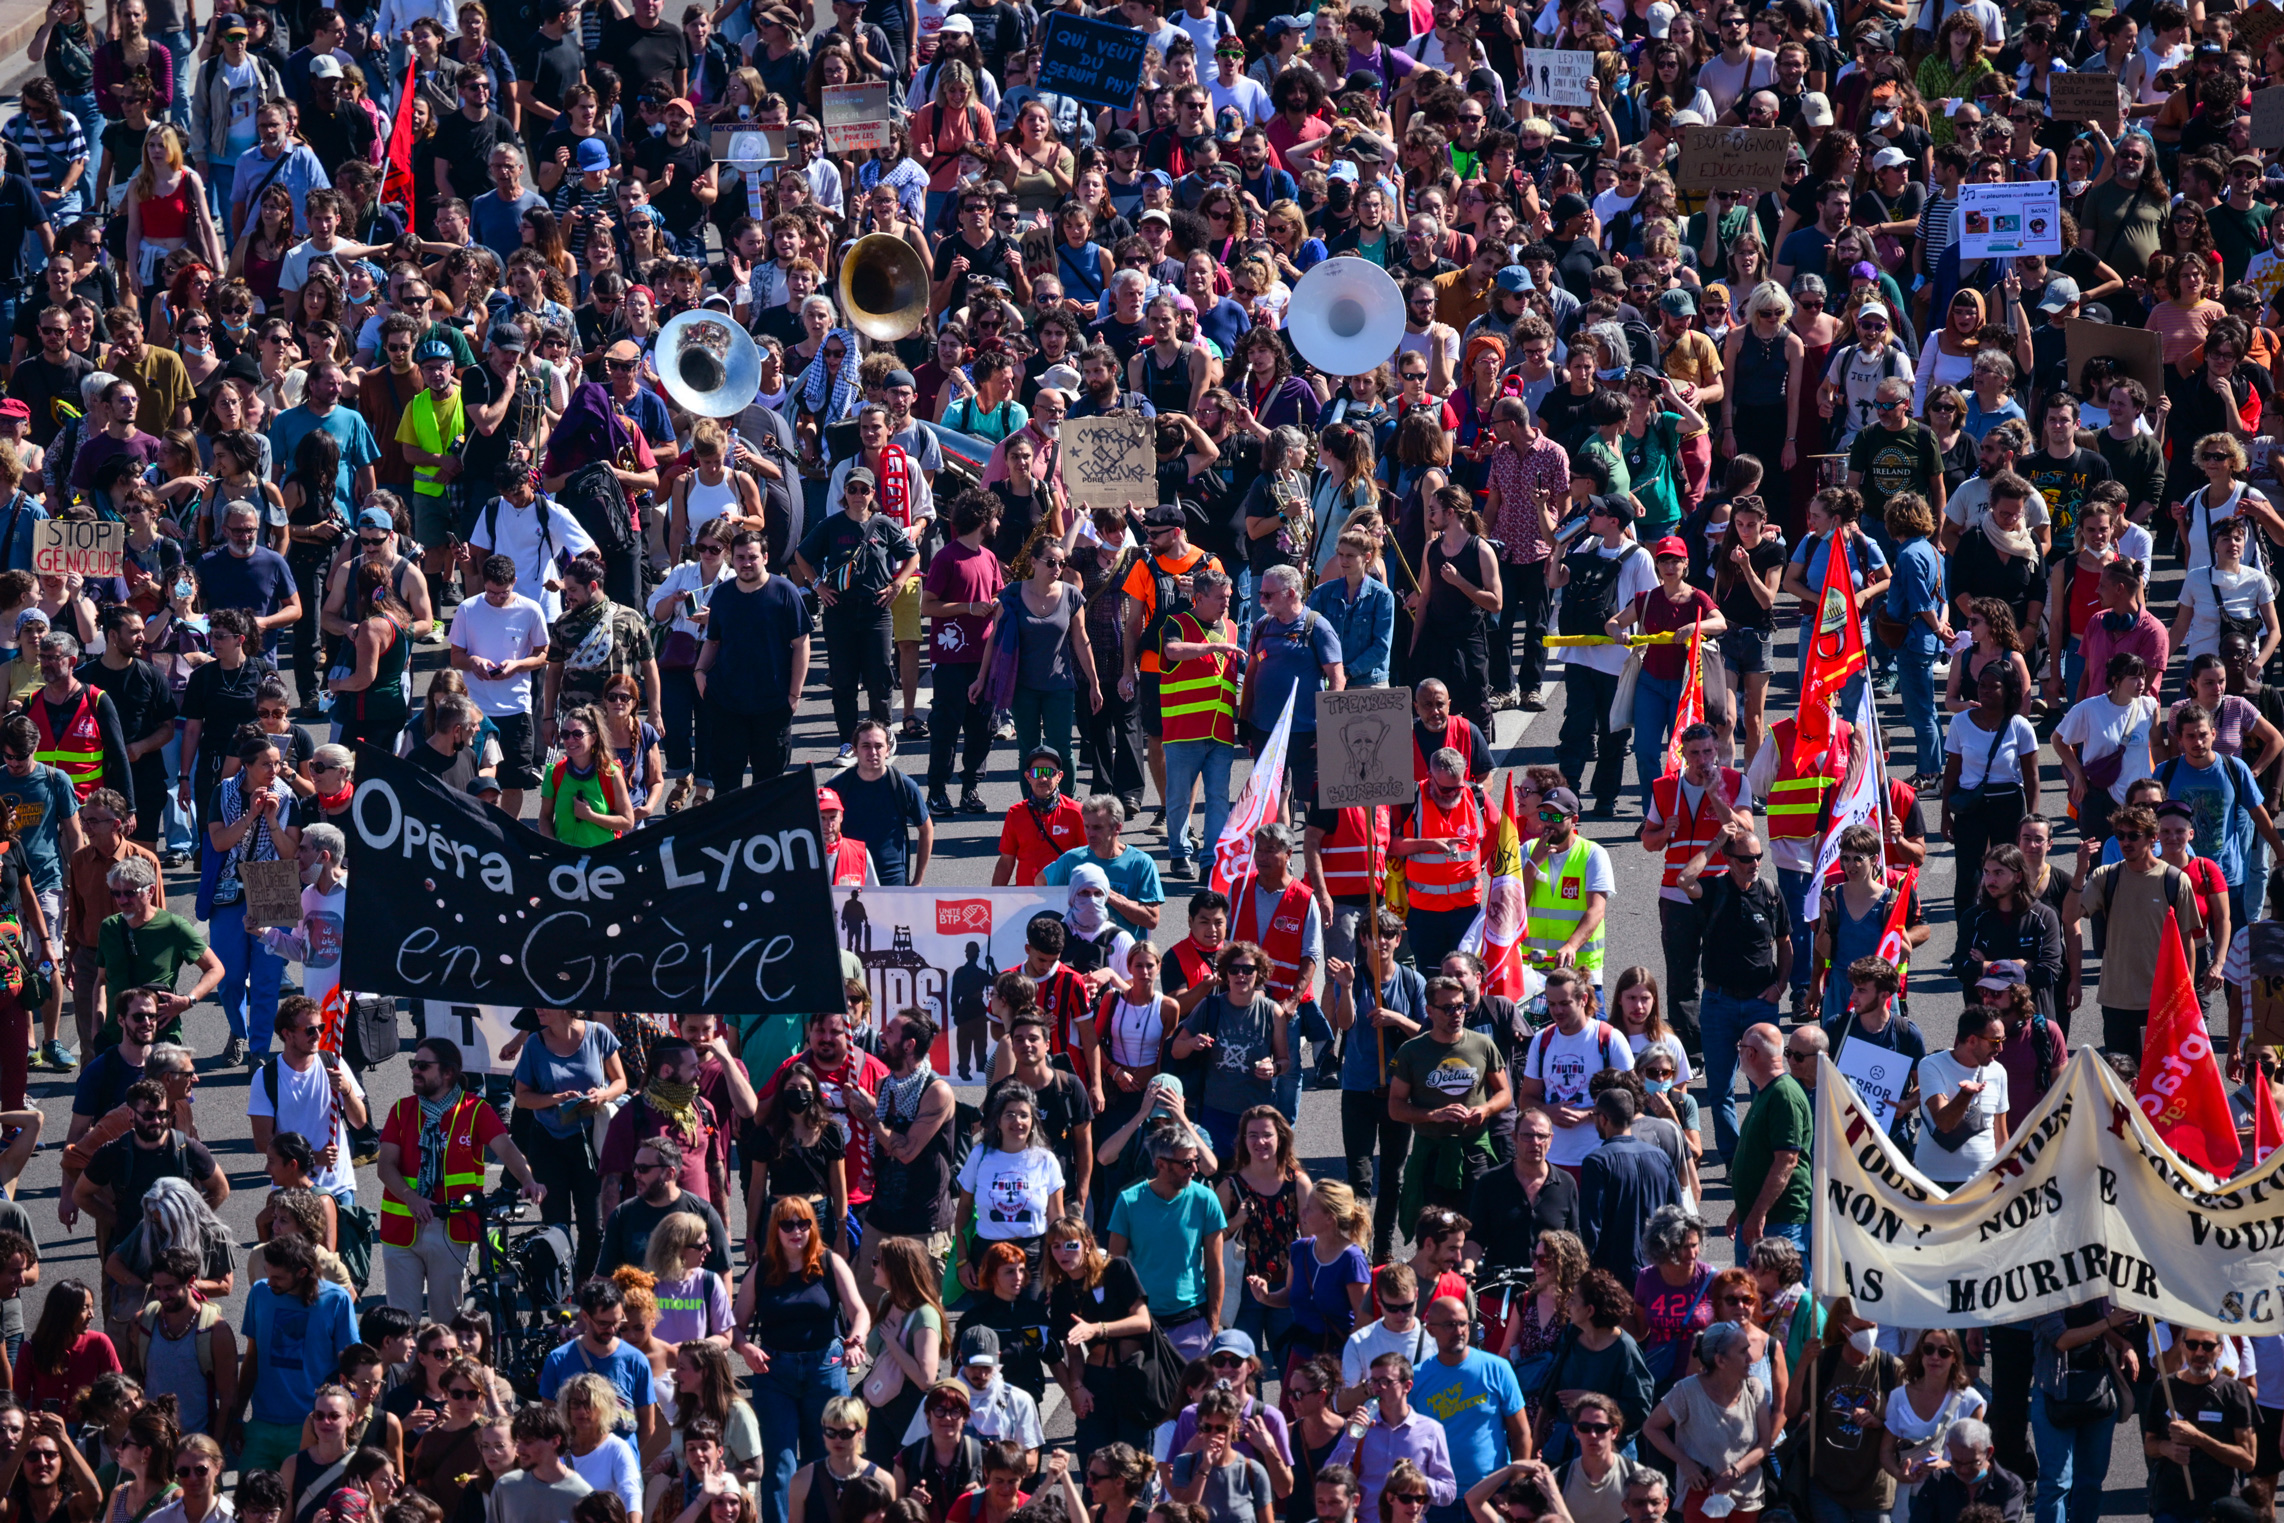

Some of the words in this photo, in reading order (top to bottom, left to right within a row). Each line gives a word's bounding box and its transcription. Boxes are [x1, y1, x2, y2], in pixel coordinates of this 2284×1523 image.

[1057, 26, 1089, 51] QUI
[1097, 38, 1140, 62] VEUT
[1079, 53, 1105, 70] DU
[1046, 60, 1098, 88] SERUM
[1104, 77, 1135, 96] PHY
[726, 124, 759, 132] CHIOTTES
[828, 126, 841, 134] ET
[842, 121, 881, 133] TOUJOURS
[844, 133, 861, 141] POUR
[862, 132, 874, 140] LES
[849, 139, 881, 151] RICHES
[1721, 134, 1787, 153] POGNON
[1873, 466, 1911, 476] IRELAND
[48, 520, 112, 549] STOP
[37, 545, 123, 577] GÉNOCIDE
[1323, 692, 1407, 715] TREMBLEZ
[1327, 776, 1404, 803] BOURGEOIS
[352, 777, 515, 895] Opéra
[548, 854, 626, 902] de
[658, 826, 821, 893] Lyon
[1563, 885, 1578, 899] cgt
[938, 907, 960, 915] UNITÉ
[939, 914, 961, 925] BTP
[396, 926, 491, 989] en
[520, 909, 797, 1007] Grève
[1552, 1063, 1585, 1074] POUTOU
[992, 1180, 1029, 1191] POUTOU
[1828, 1178, 1904, 1244] NON
[1979, 1175, 2063, 1243] NOUS
[1844, 1260, 1884, 1302] AS
[1946, 1241, 2109, 1314] MOURIR
[655, 1297, 704, 1311] mour
